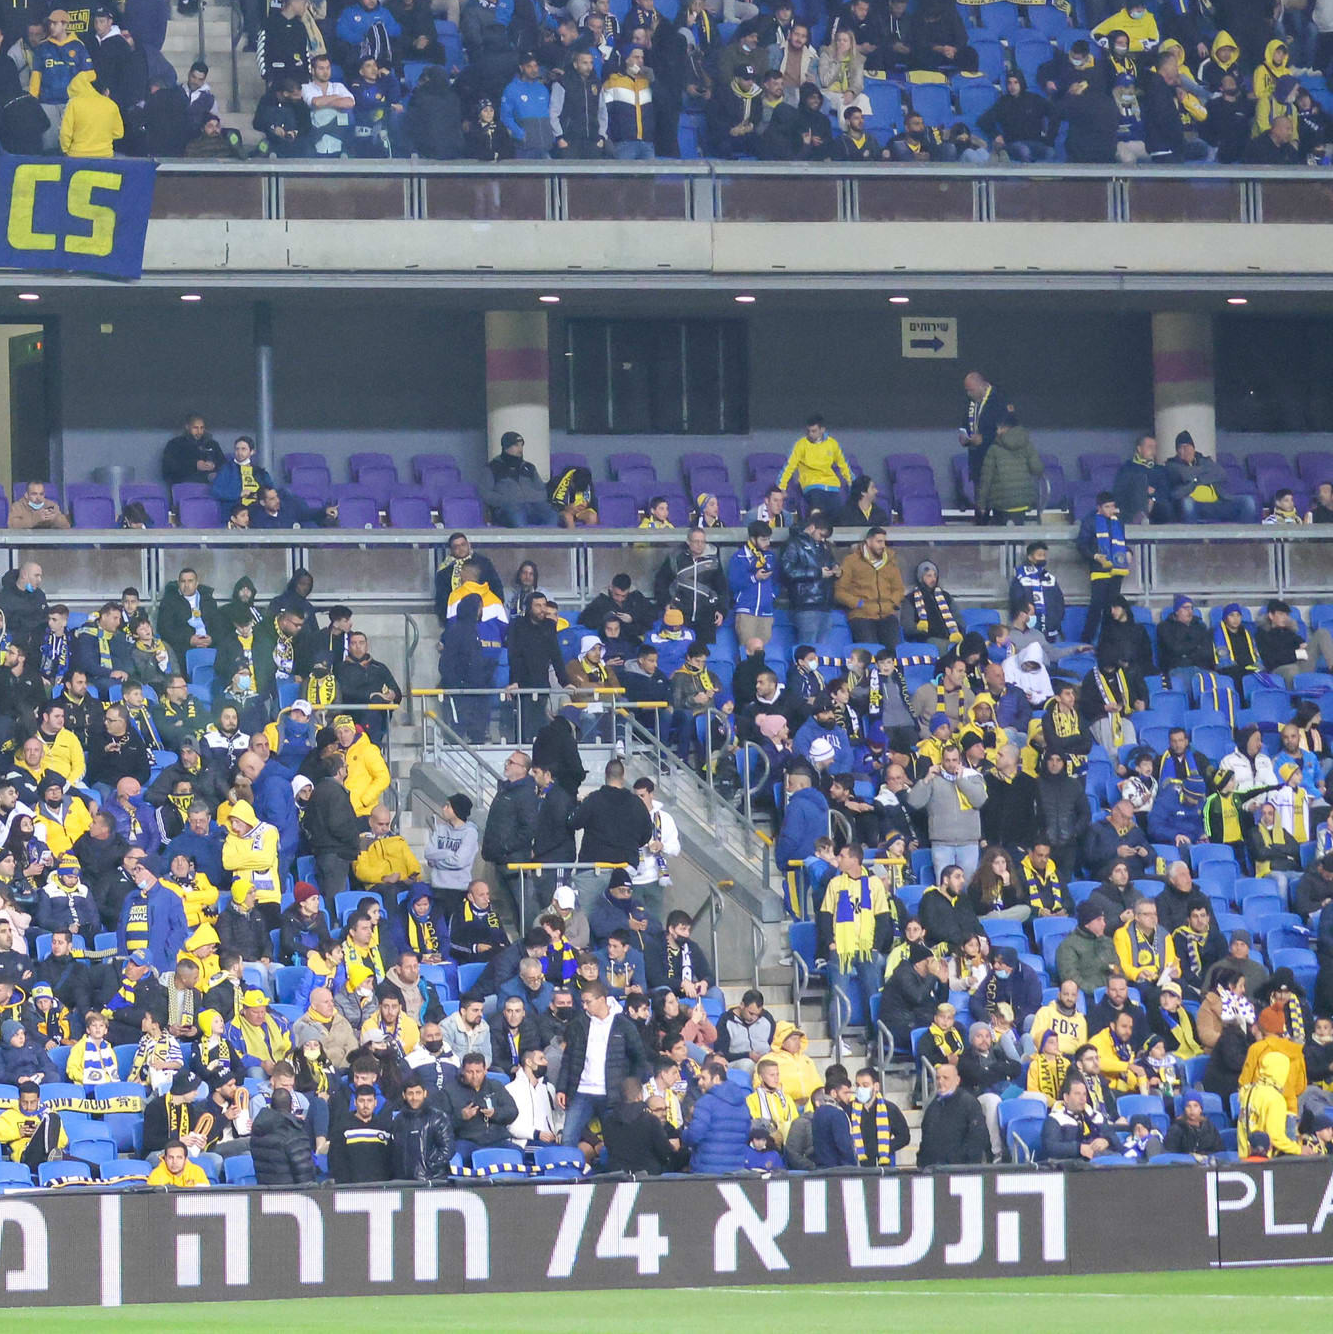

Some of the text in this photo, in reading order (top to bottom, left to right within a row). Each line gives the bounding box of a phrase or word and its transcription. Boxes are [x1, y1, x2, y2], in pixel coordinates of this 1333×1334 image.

[909, 322, 949, 332] שירותים
[1051, 1021, 1078, 1037] FOX
[176, 1188, 491, 1286] חדרה
[537, 1181, 670, 1278] 74
[713, 1170, 1066, 1273] הנשיא
